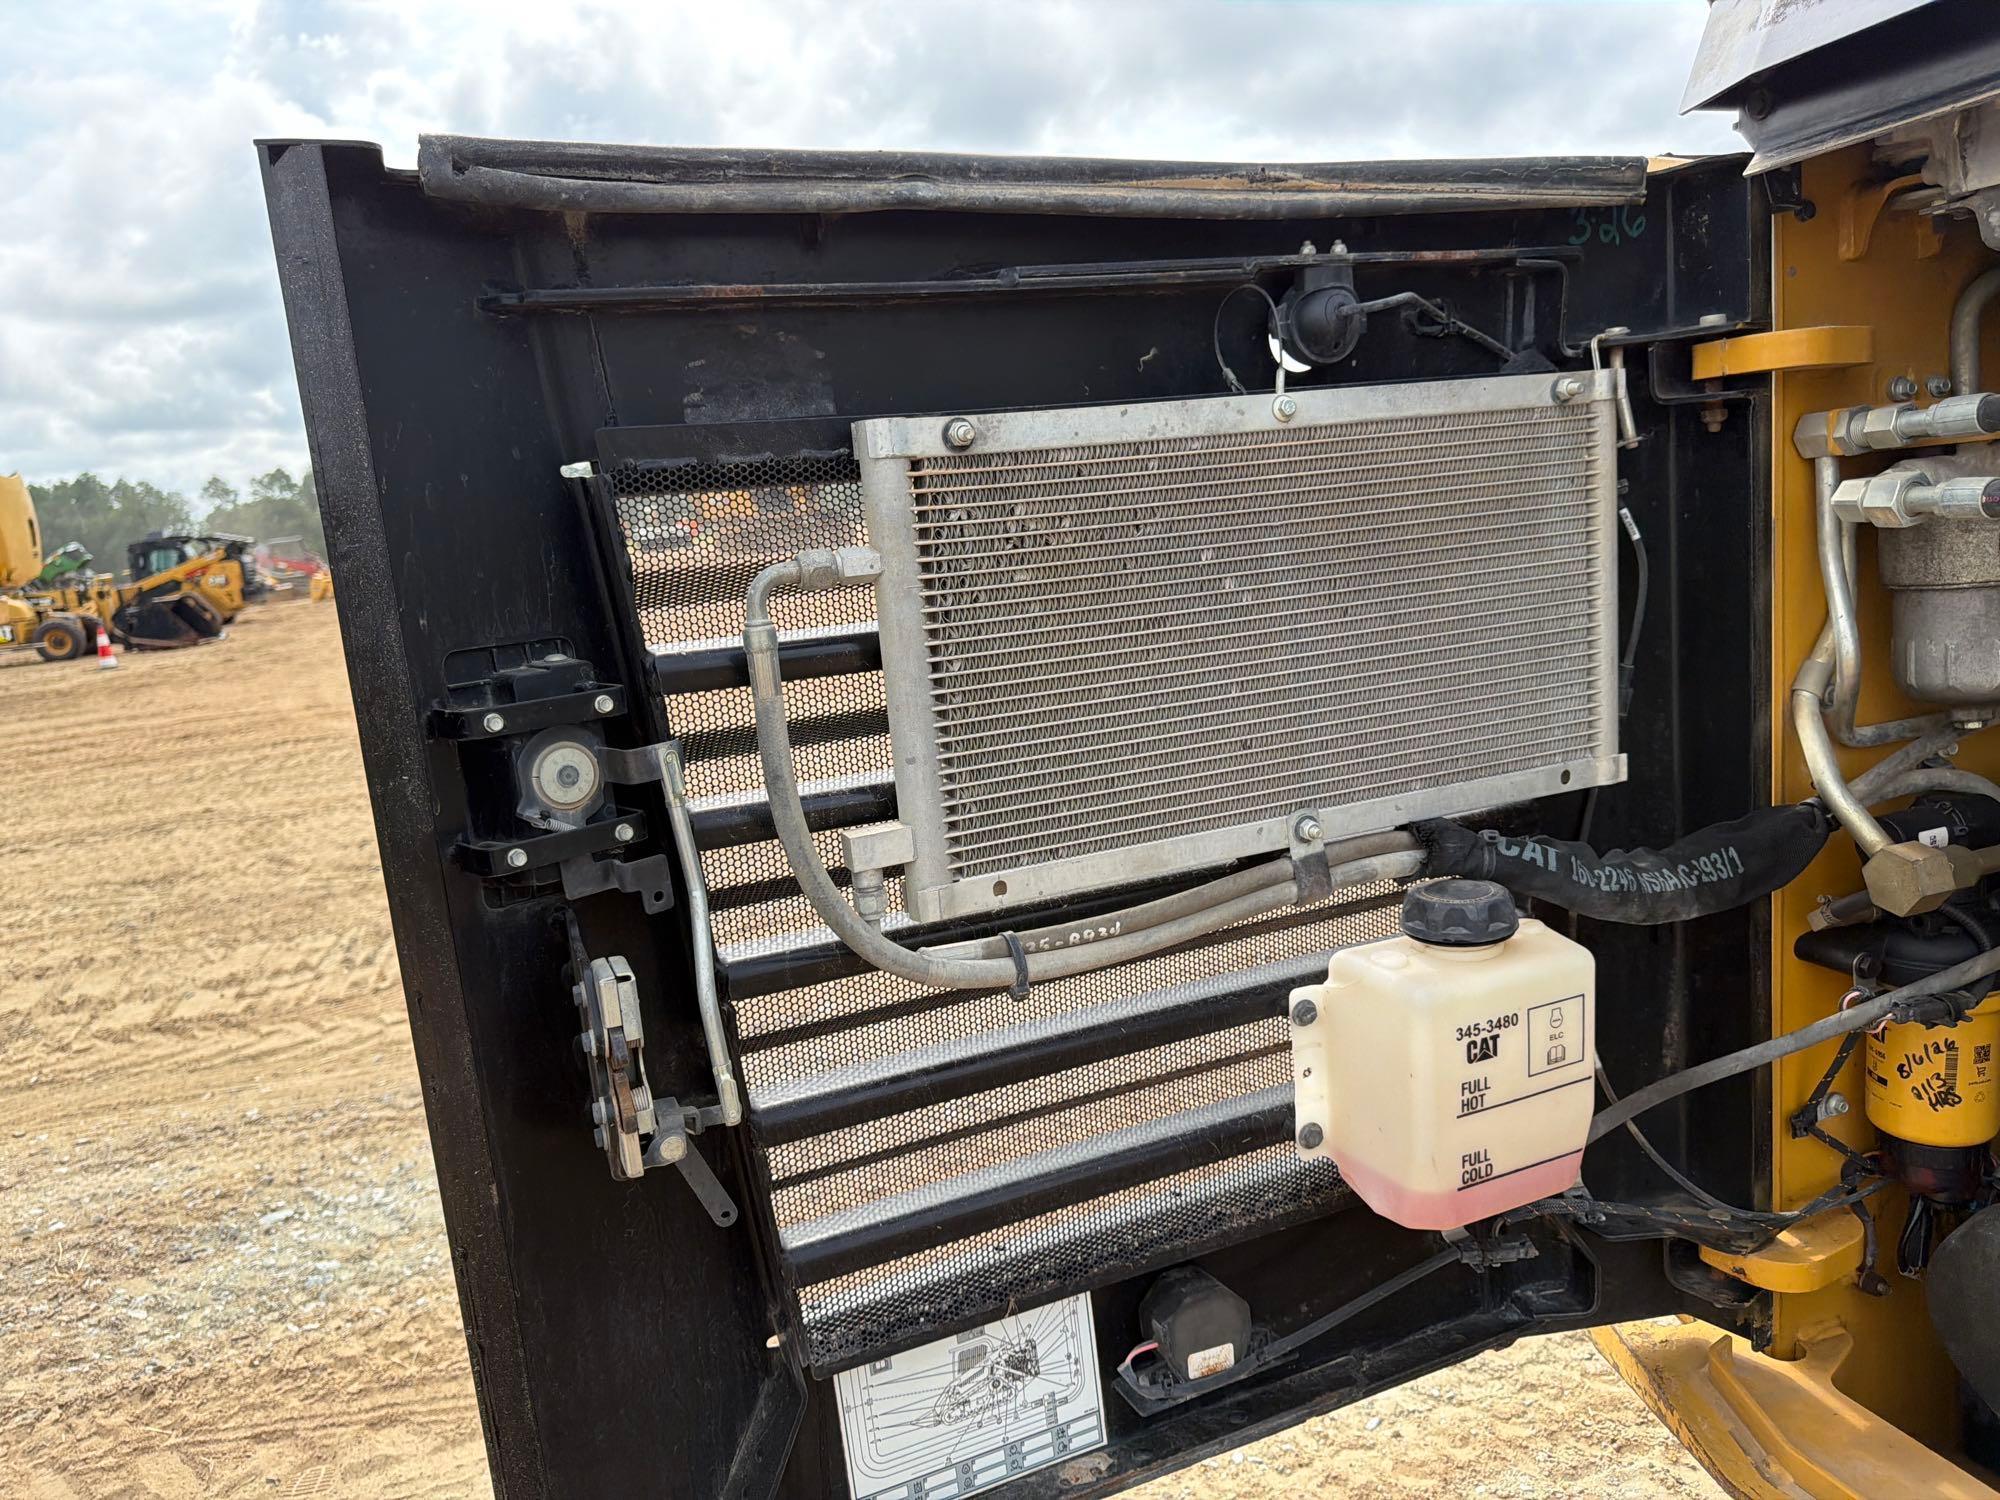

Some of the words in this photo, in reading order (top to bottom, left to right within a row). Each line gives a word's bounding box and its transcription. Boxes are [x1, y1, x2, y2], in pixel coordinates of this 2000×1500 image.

[1497, 837, 1560, 872] CAT
[1456, 1013, 1519, 1042] 345-3480
[1549, 1031, 1564, 1041] ELC
[1466, 1034, 1500, 1064] CAT
[1461, 1076, 1491, 1097] FULL
[1461, 1093, 1486, 1113] HOT
[1461, 1148, 1491, 1169] FULL
[1461, 1163, 1493, 1185] COLD
